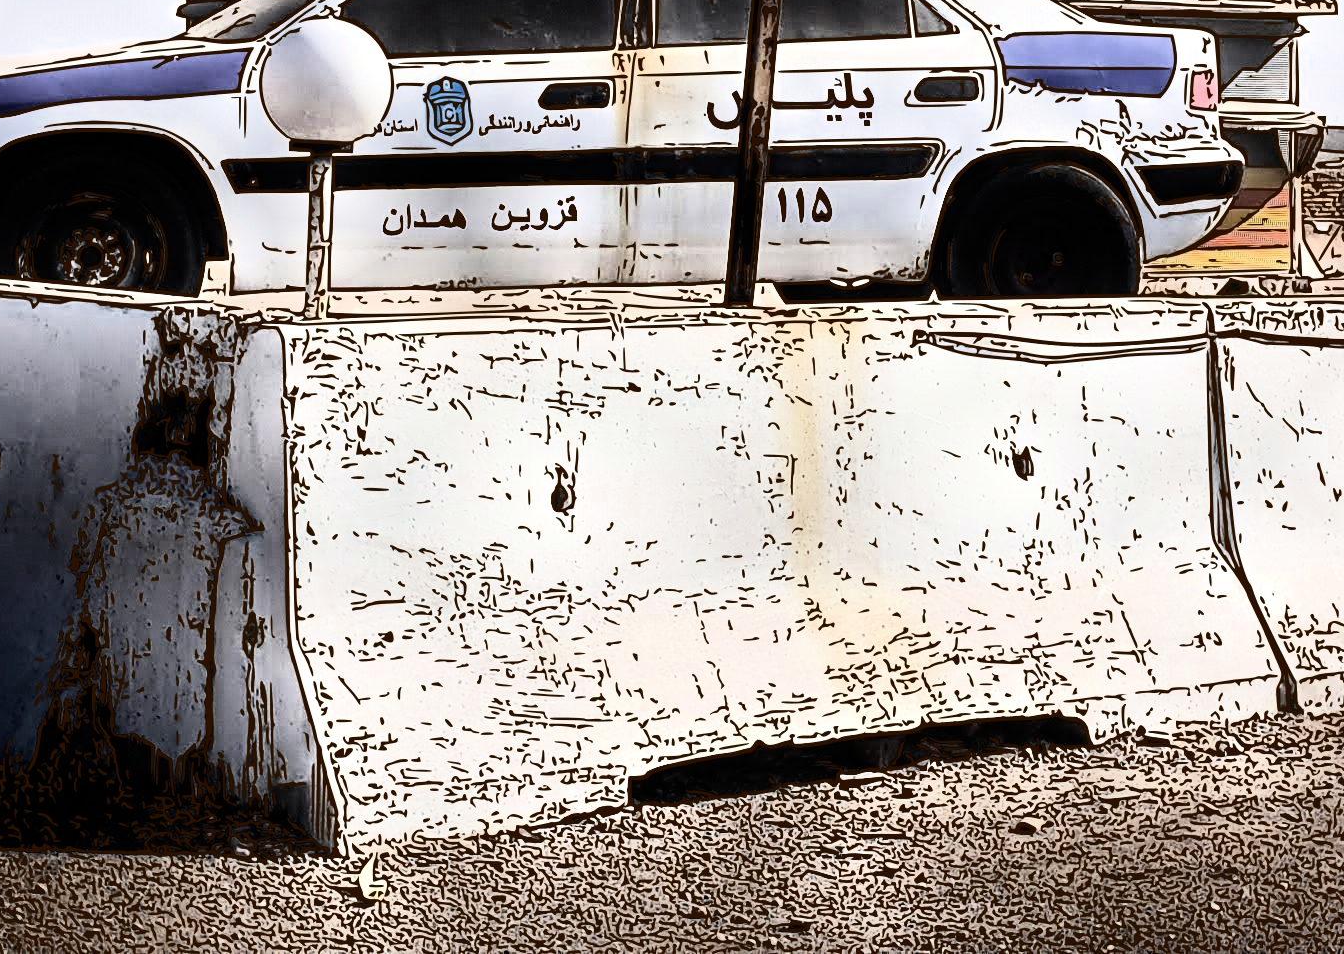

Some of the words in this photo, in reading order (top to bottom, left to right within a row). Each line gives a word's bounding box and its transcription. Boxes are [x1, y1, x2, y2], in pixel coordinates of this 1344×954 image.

[383, 118, 419, 137] استان
[382, 203, 467, 236] همدان
[491, 195, 578, 232] قزوین
[777, 186, 833, 224] ۱۱۵
